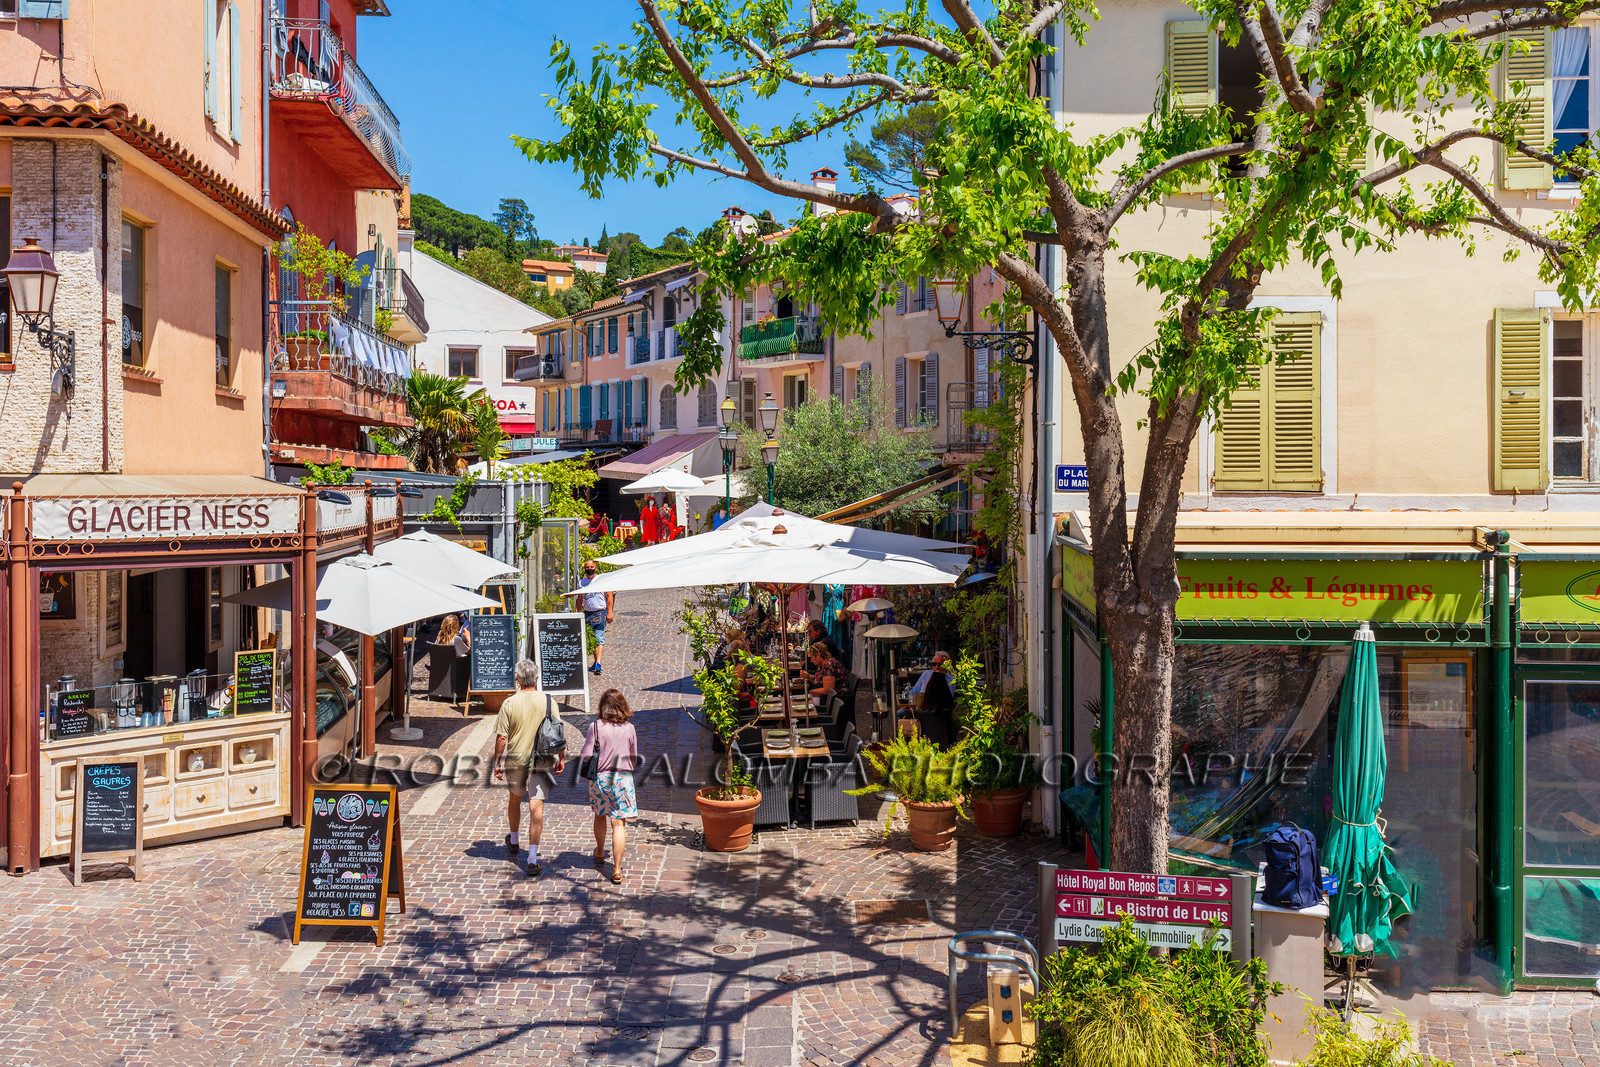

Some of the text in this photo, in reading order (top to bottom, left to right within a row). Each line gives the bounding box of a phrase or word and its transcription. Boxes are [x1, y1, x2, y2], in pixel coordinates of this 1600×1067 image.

[533, 437, 560, 446] JULES
[1058, 479, 1089, 488] DU MAR
[1063, 469, 1088, 478] PLAC
[67, 503, 271, 533] GLACIER NESS
[1178, 575, 1434, 607] Fruits & Légumes
[92, 776, 132, 786] GAUFRES
[1057, 874, 1156, 895] Hôtel Royal Bon Repos
[1107, 901, 1229, 922] Le Bistrot de Louis
[1059, 922, 1083, 939] Lydie
[1148, 928, 1195, 945] Immobilier
